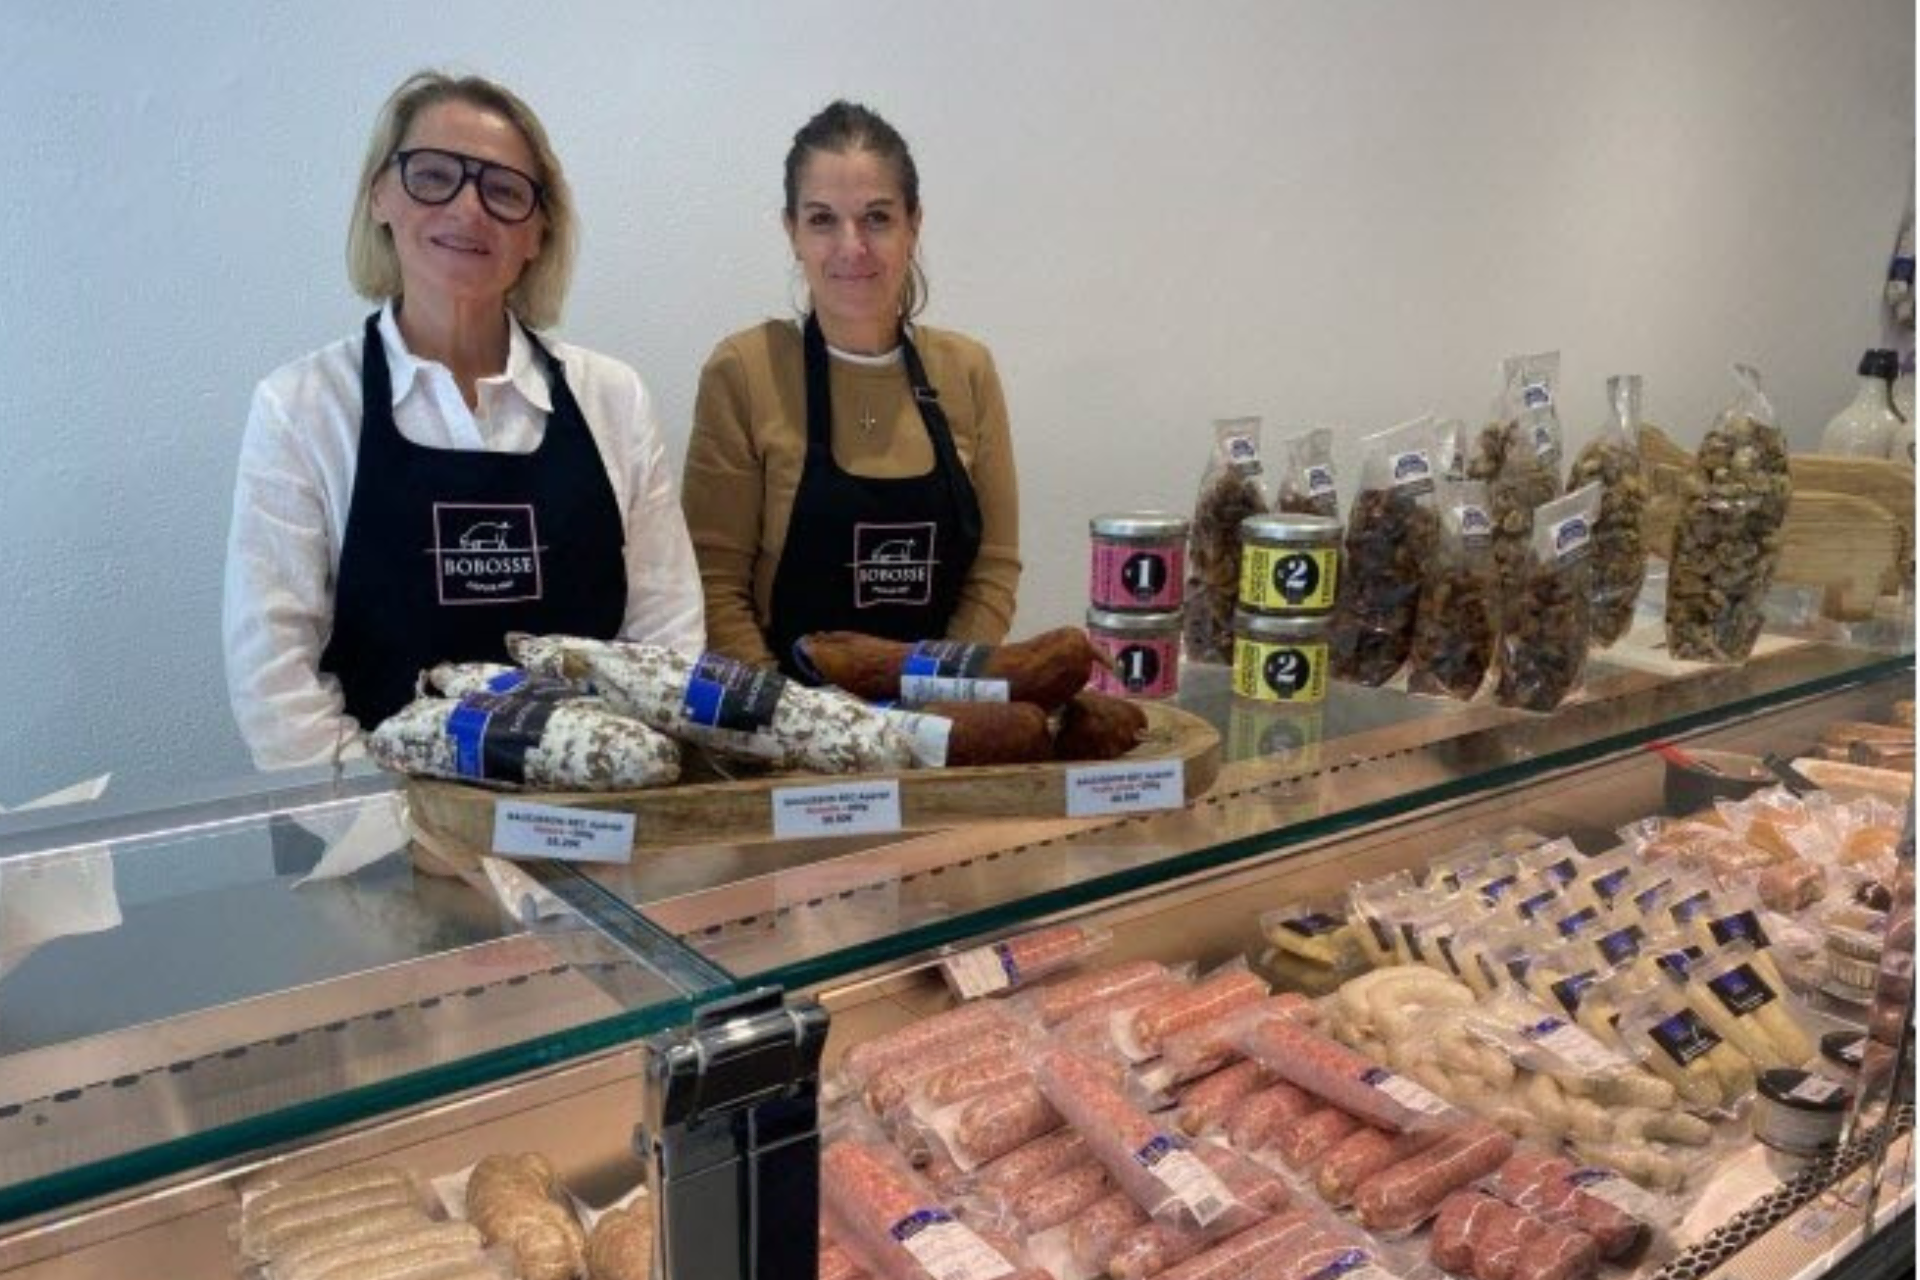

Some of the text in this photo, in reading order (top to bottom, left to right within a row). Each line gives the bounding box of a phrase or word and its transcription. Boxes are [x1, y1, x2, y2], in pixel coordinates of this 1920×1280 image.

[444, 557, 533, 576] BOBOSSE
[1137, 558, 1152, 589] 1
[1285, 559, 1308, 588] 2
[1130, 651, 1144, 679] 1
[1276, 654, 1298, 682] 2
